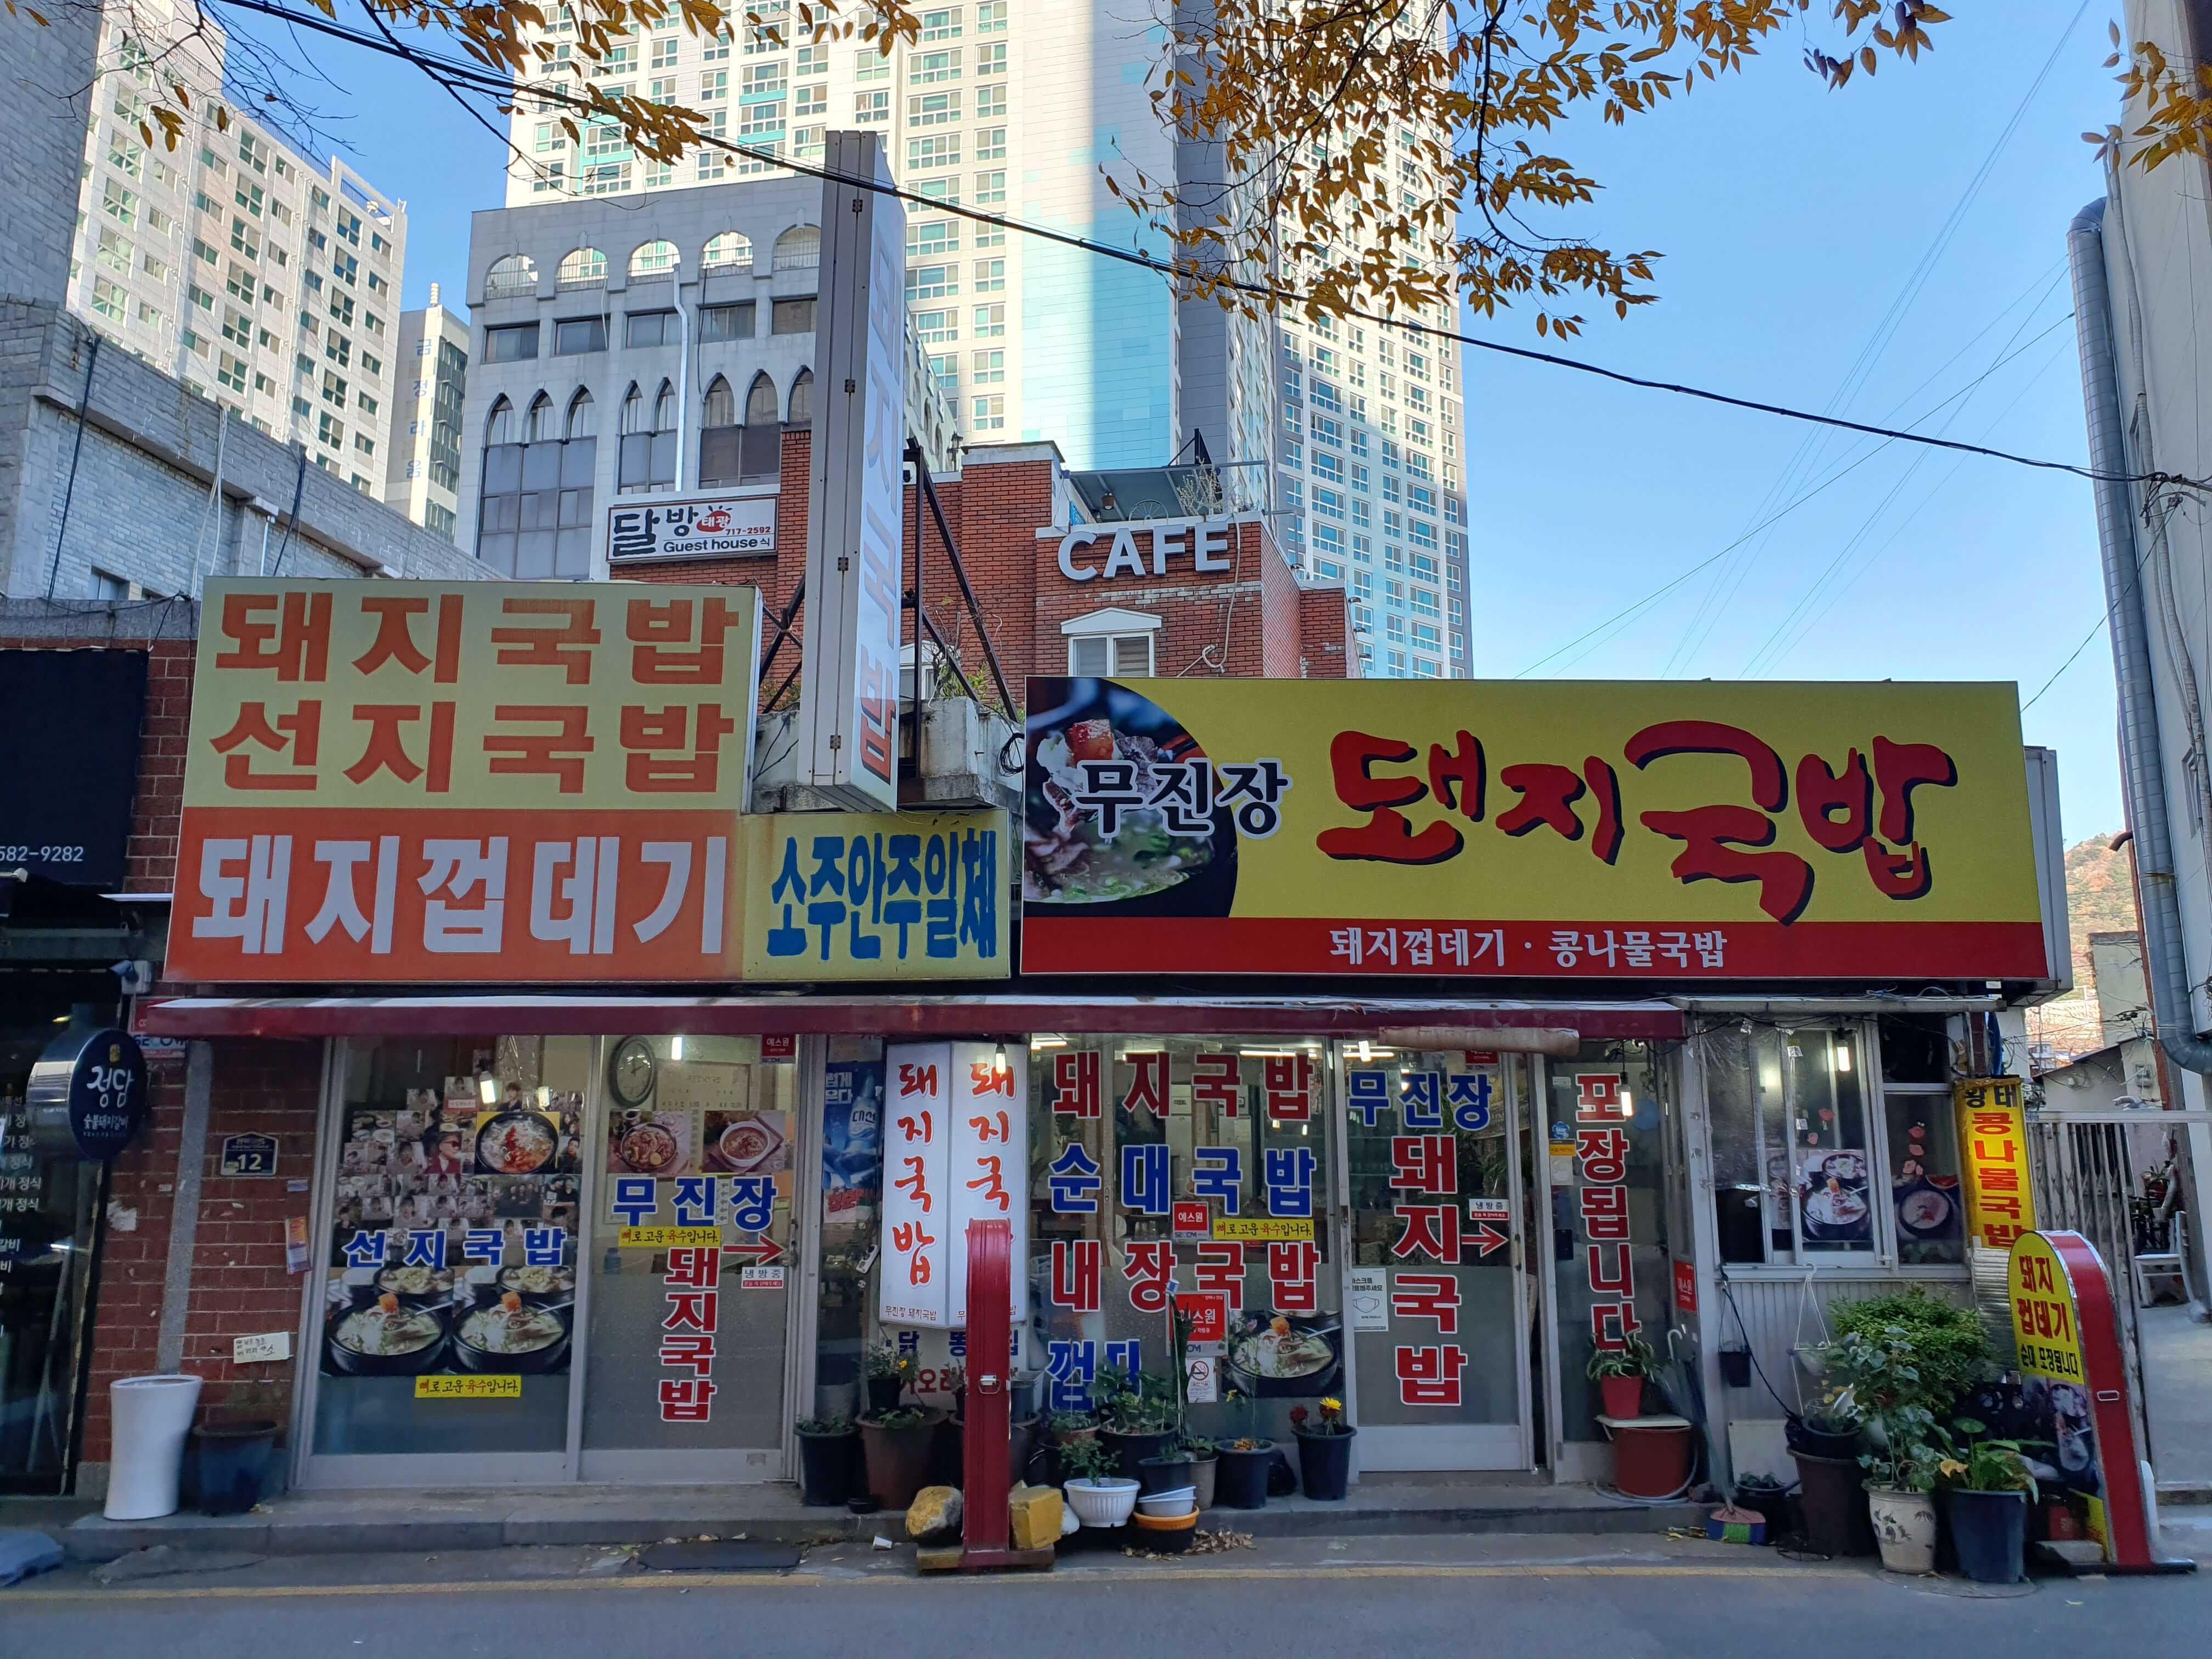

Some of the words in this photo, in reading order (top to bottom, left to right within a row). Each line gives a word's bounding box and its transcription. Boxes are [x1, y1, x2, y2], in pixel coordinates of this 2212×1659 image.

[612, 505, 699, 557] 달방
[663, 539, 708, 552] Guest
[712, 537, 758, 550] house
[701, 515, 730, 528] 태광
[725, 526, 771, 535] 717-2592
[1058, 521, 1231, 581] CAFE
[215, 592, 739, 685] 돼지국밥
[209, 699, 734, 793] 선지국밥
[1075, 757, 1293, 839] 무진장
[1317, 720, 1958, 927] 돼지국밥
[192, 834, 727, 955] 돼지껍데기
[1329, 927, 1505, 967] 돼지껍데기
[1548, 930, 1728, 968] 콩나물국밥
[1052, 1050, 1315, 1121] 돼지국밥
[1347, 1070, 1493, 1131] 무진장
[18, 1176, 42, 1190] 정식
[237, 1153, 262, 1170] 12
[892, 1062, 938, 1286] 돼지국밥
[1048, 1143, 1317, 1216] 순대국밥
[1971, 1112, 2024, 1249] 콩나물국밥
[15, 1198, 40, 1212] 정식
[612, 1175, 778, 1232] 무진장
[1178, 1211, 1203, 1223] 에스원
[1238, 1223, 1257, 1236] 고운
[1575, 1073, 1642, 1356] 포장됩니다
[342, 1227, 567, 1269] 선지국밥
[644, 1231, 664, 1244] 고운
[1051, 1240, 1321, 1313] 내장국밥
[1389, 1135, 1468, 1406] 돼지국밥
[2018, 1255, 2055, 1295] 돼지
[658, 1246, 721, 1423] 돼지국밥
[885, 1305, 906, 1318] 무진장
[908, 1307, 937, 1321] 돼지국밥
[2016, 1297, 2071, 1343] 껍데기
[2021, 1344, 2037, 1368] 순대
[442, 1379, 464, 1393] 고운
